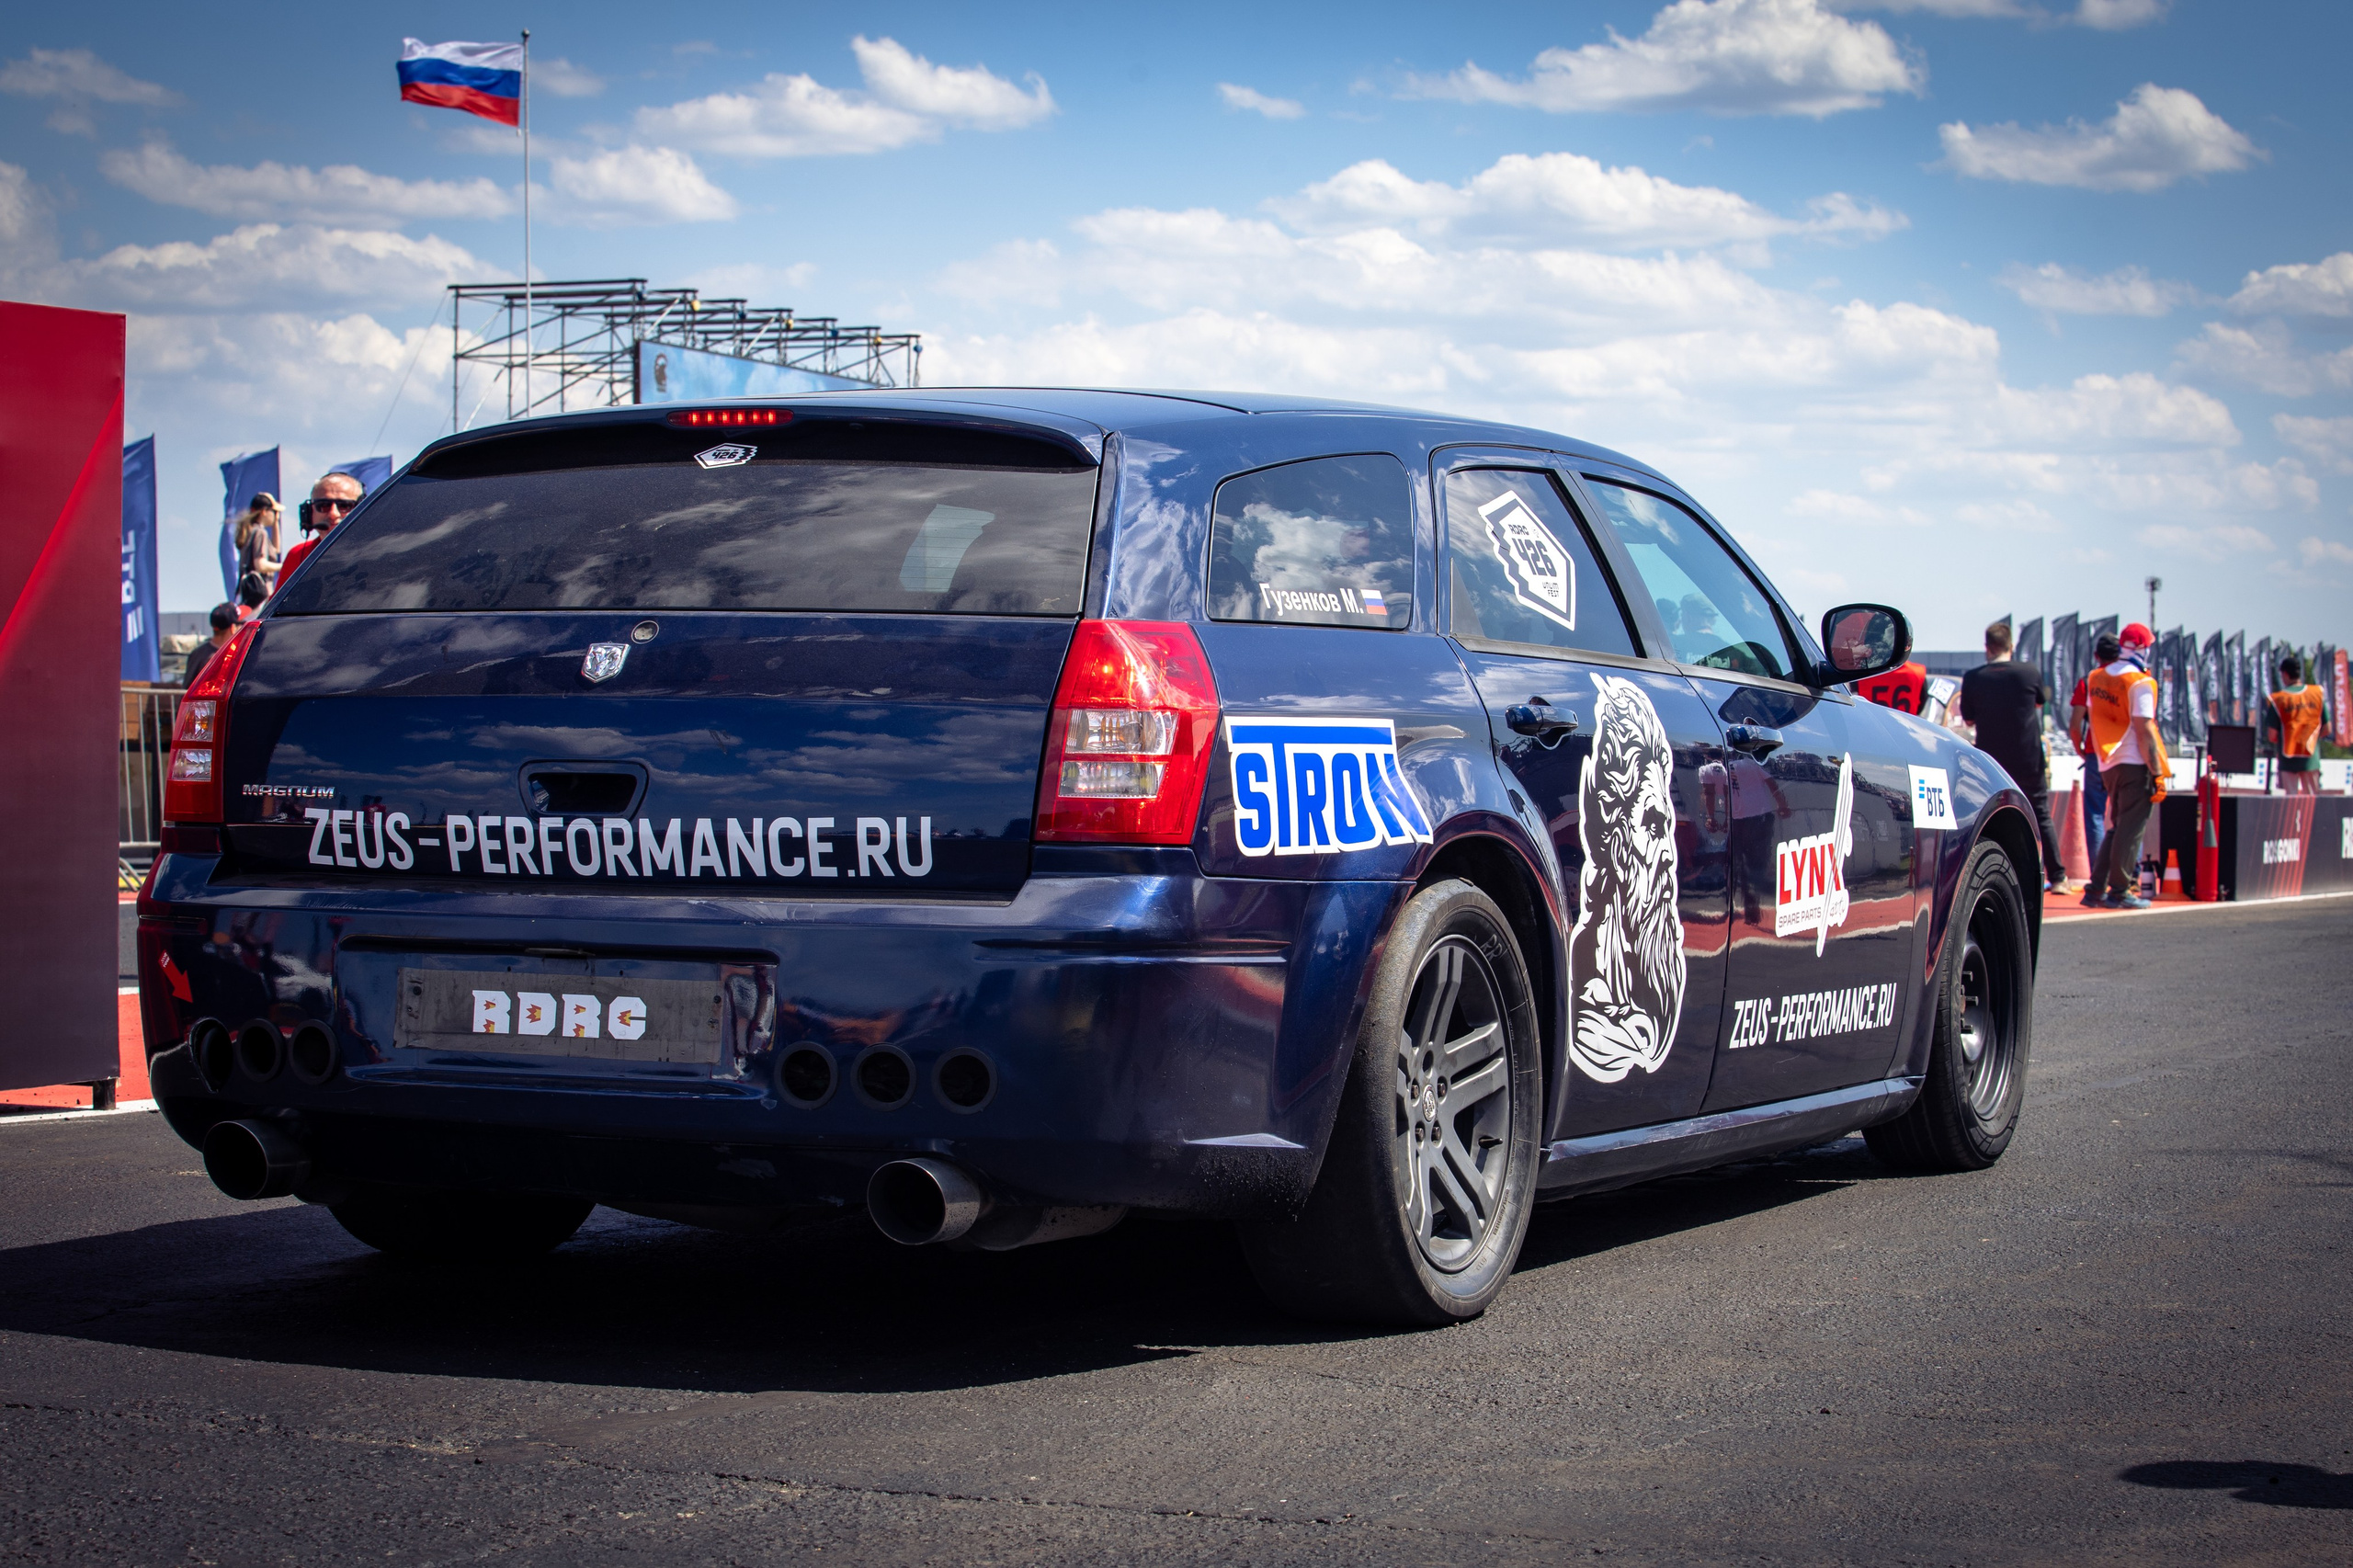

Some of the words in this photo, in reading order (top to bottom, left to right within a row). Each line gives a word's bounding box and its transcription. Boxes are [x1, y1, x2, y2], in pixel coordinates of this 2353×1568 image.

[711, 451, 739, 460] 426
[1511, 538, 1558, 577] 426
[1259, 583, 1342, 617] Гузенков
[242, 784, 335, 799] MAGNUM
[1927, 787, 1945, 818] ВТБ
[304, 808, 933, 878] ZEUS-PERFORMANCE.RU
[1779, 842, 1842, 906] LYNX
[1779, 911, 1801, 928] SPARE
[1801, 906, 1823, 923] PARTS
[472, 989, 647, 1040] RDRC
[1728, 982, 1897, 1050] ZEUS-PERFORMANCE.RU
